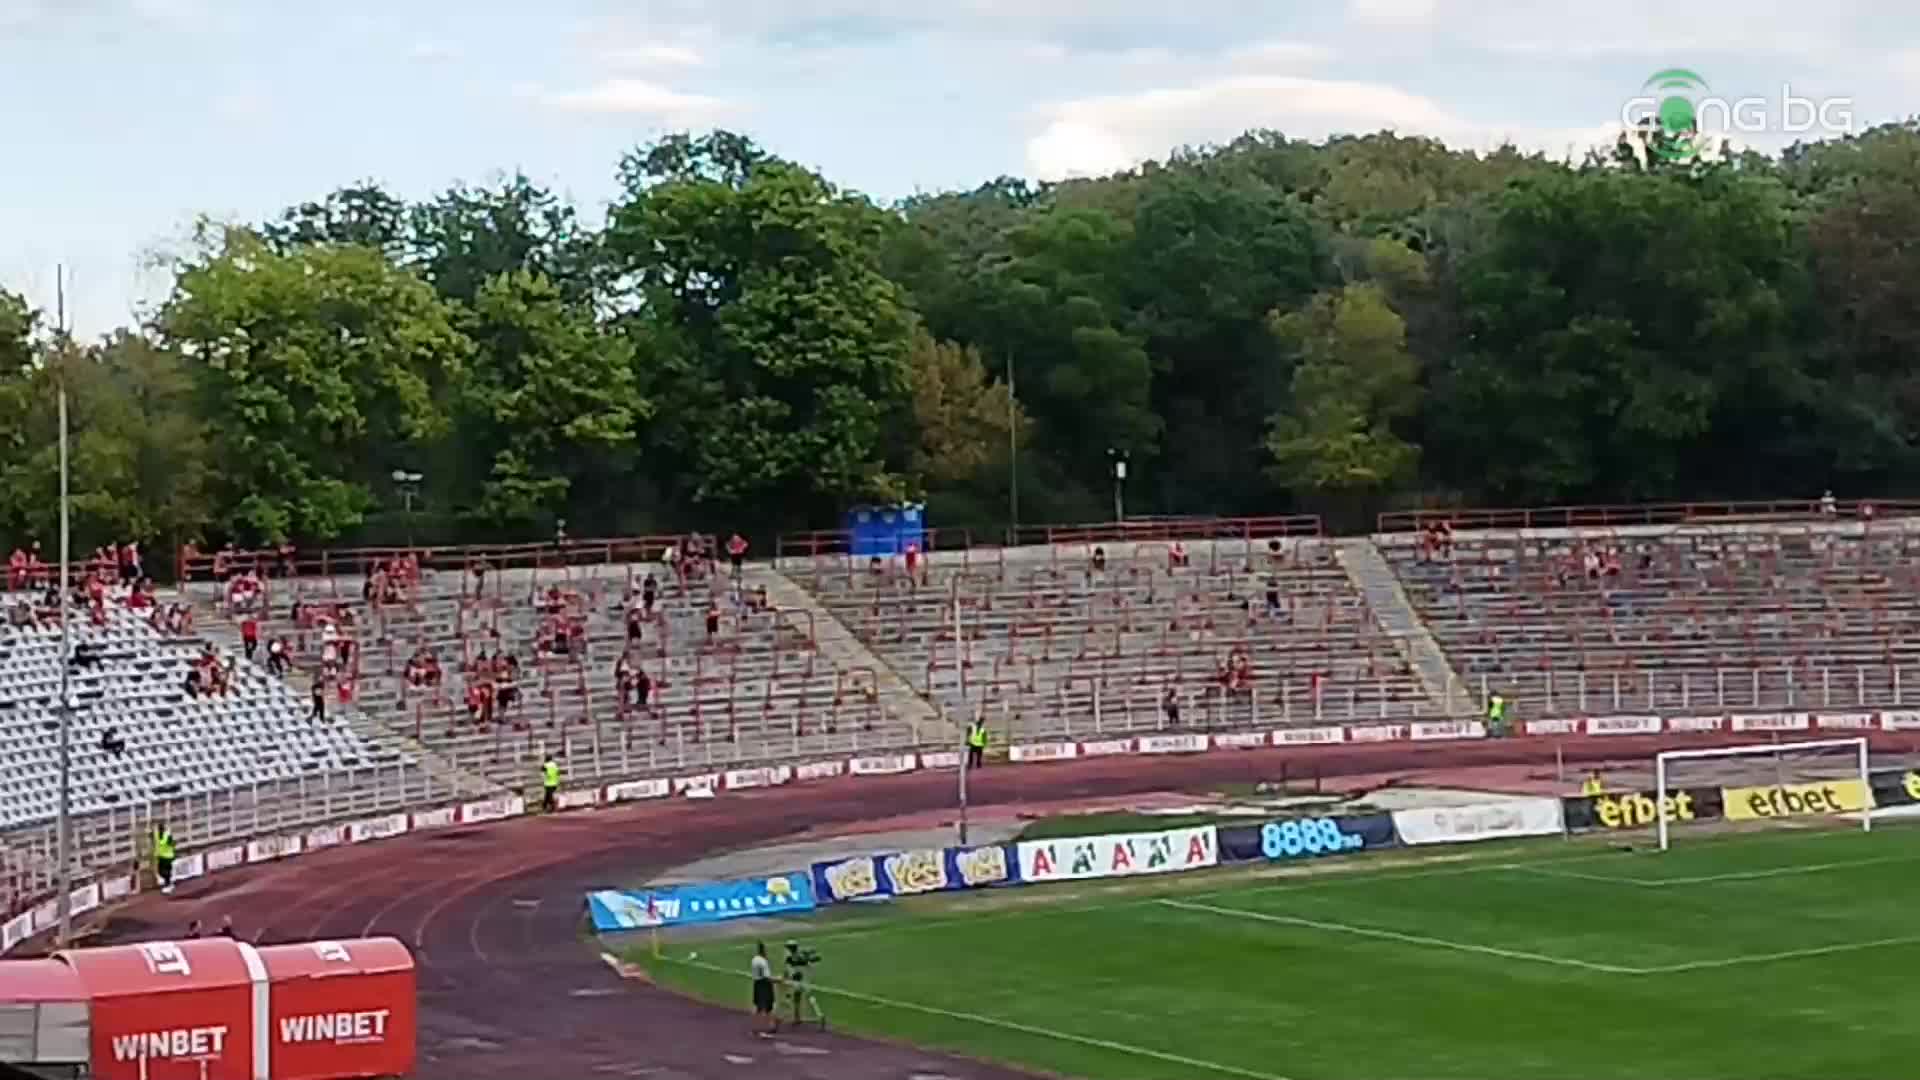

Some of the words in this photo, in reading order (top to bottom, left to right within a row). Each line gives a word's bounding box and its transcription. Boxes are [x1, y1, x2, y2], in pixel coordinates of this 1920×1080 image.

[1597, 789, 1695, 828] efbet
[1749, 786, 1841, 817] efbet
[280, 1010, 389, 1042] WINBET
[112, 1027, 228, 1060] WINBET
